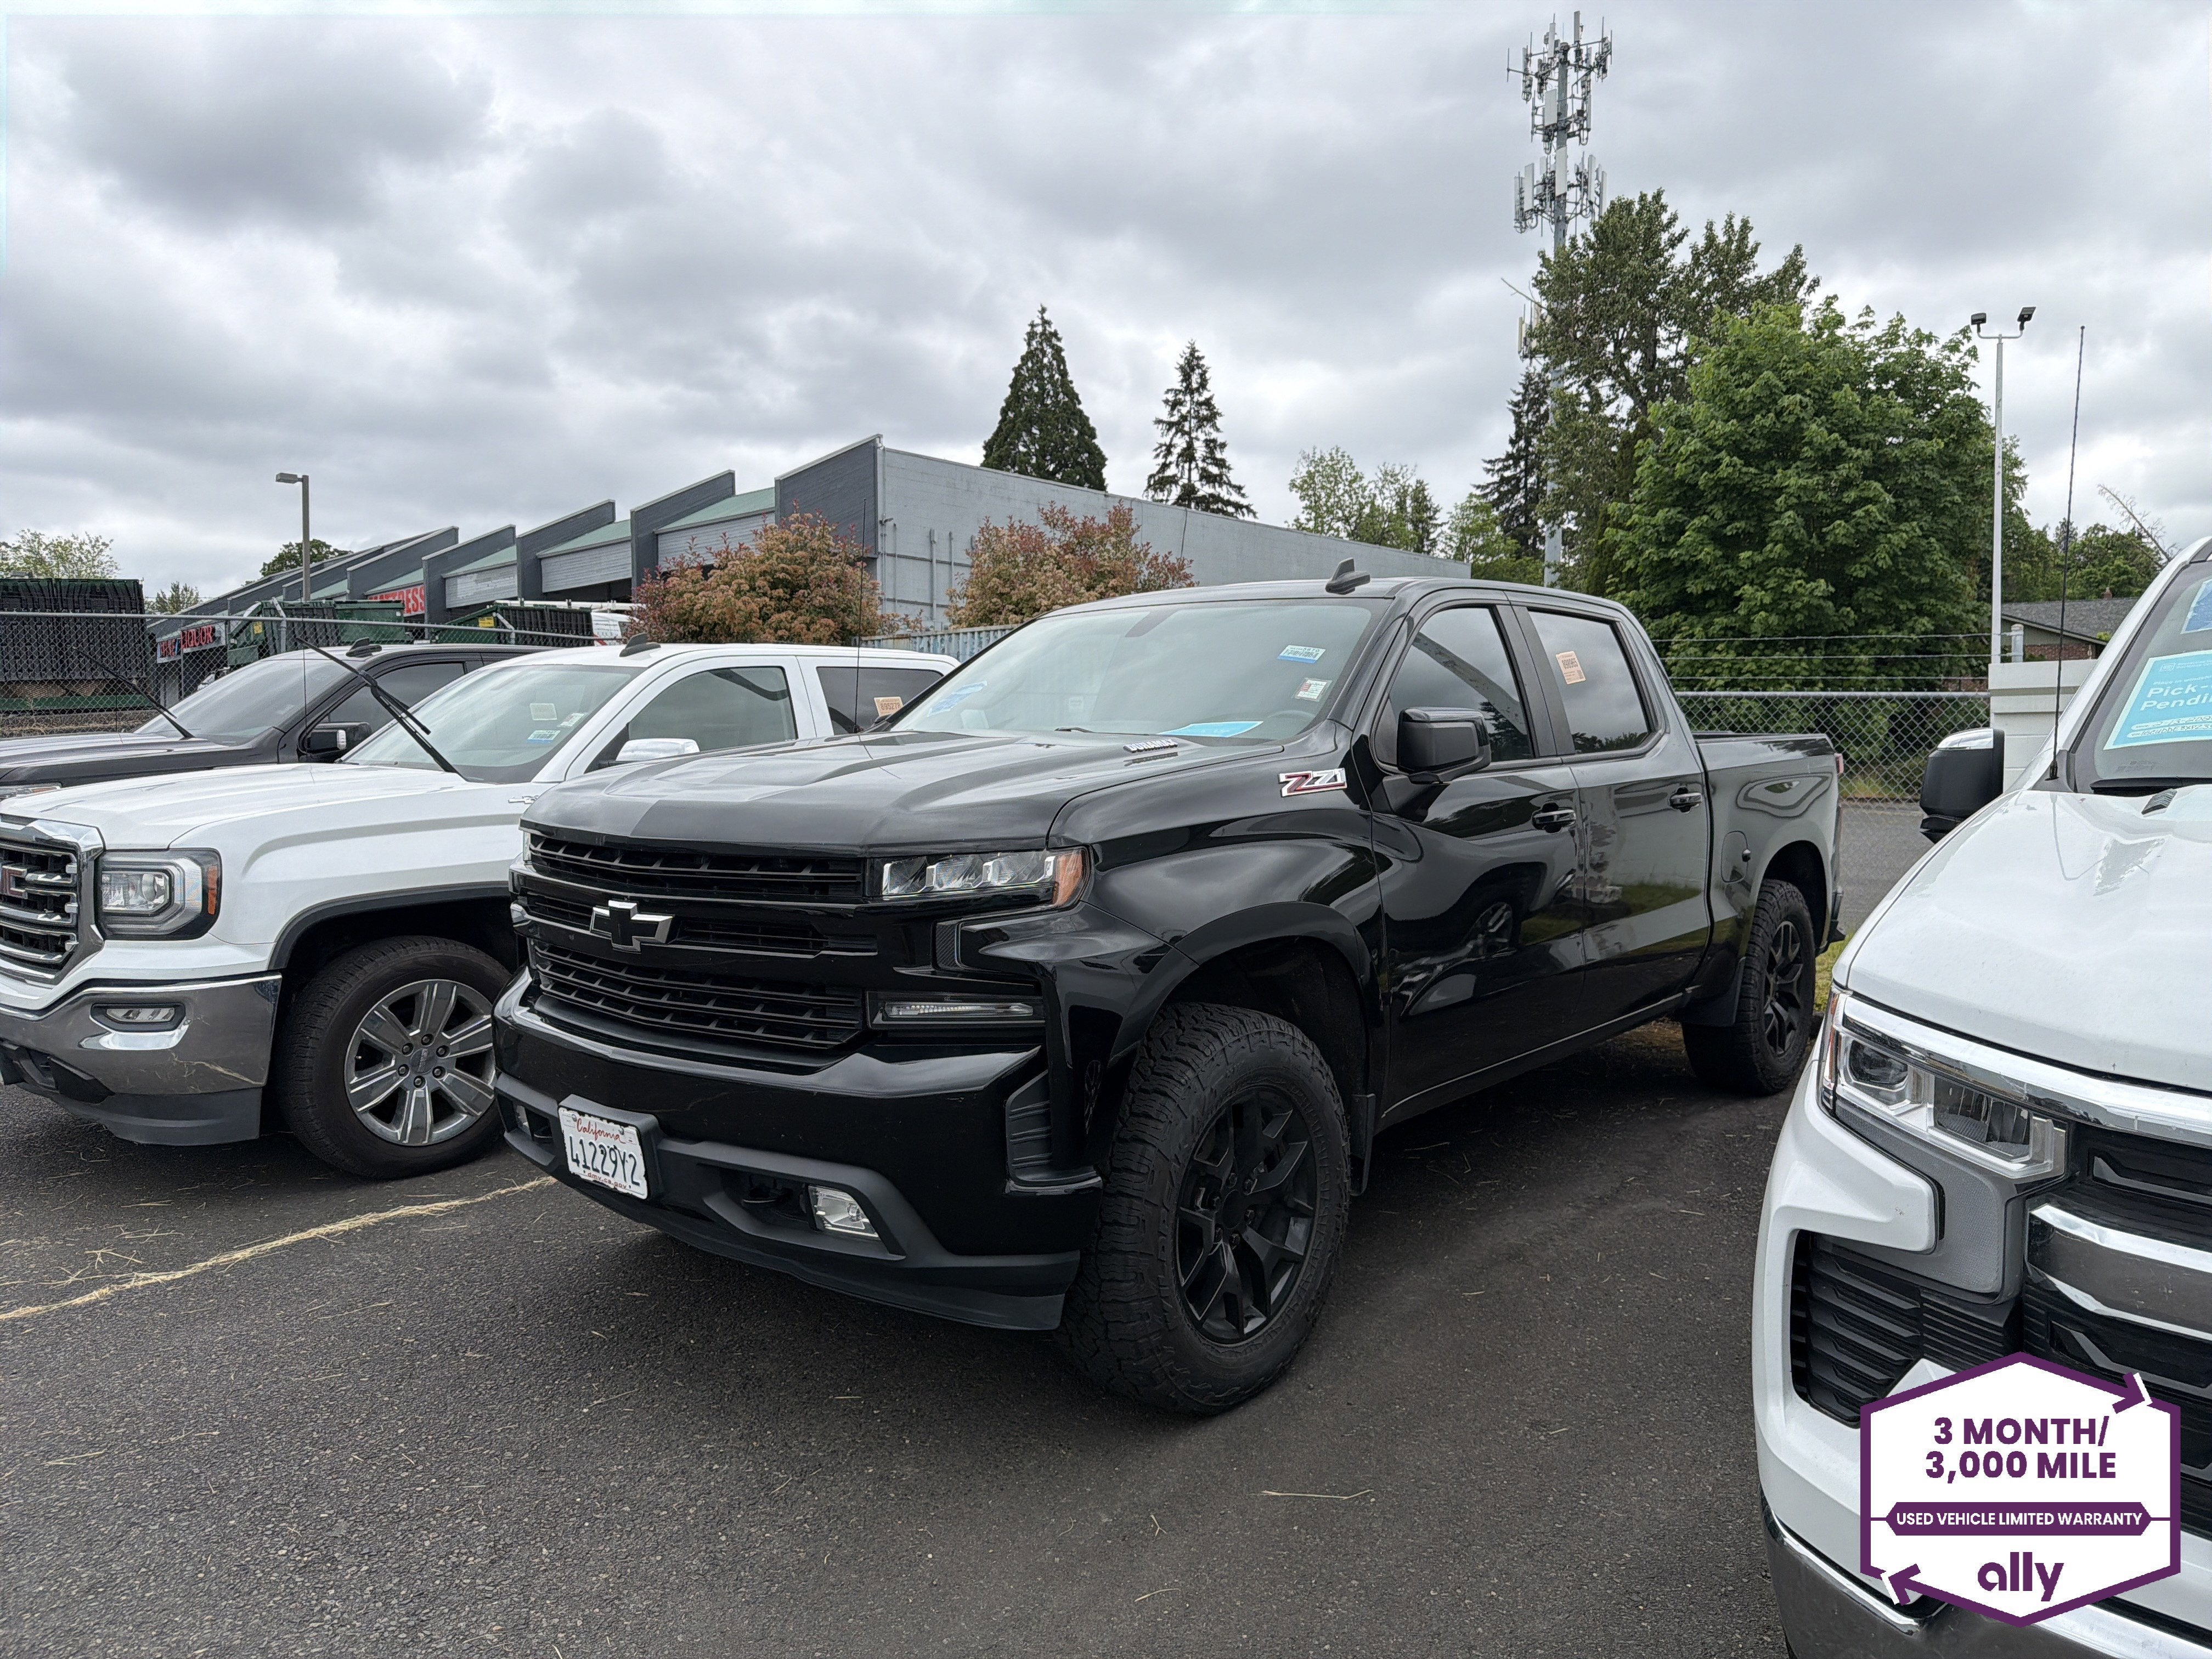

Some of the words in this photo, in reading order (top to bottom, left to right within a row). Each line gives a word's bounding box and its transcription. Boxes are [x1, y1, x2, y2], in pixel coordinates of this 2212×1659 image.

[180, 624, 214, 650] LIQUOR
[2147, 684, 2212, 697] Pick-
[1123, 738, 1178, 753] DURAMAX
[1278, 768, 1347, 797] Z71
[577, 1118, 627, 1144] California
[569, 1136, 640, 1187] 41229Y2
[587, 1172, 627, 1189] dmv.ca.gov
